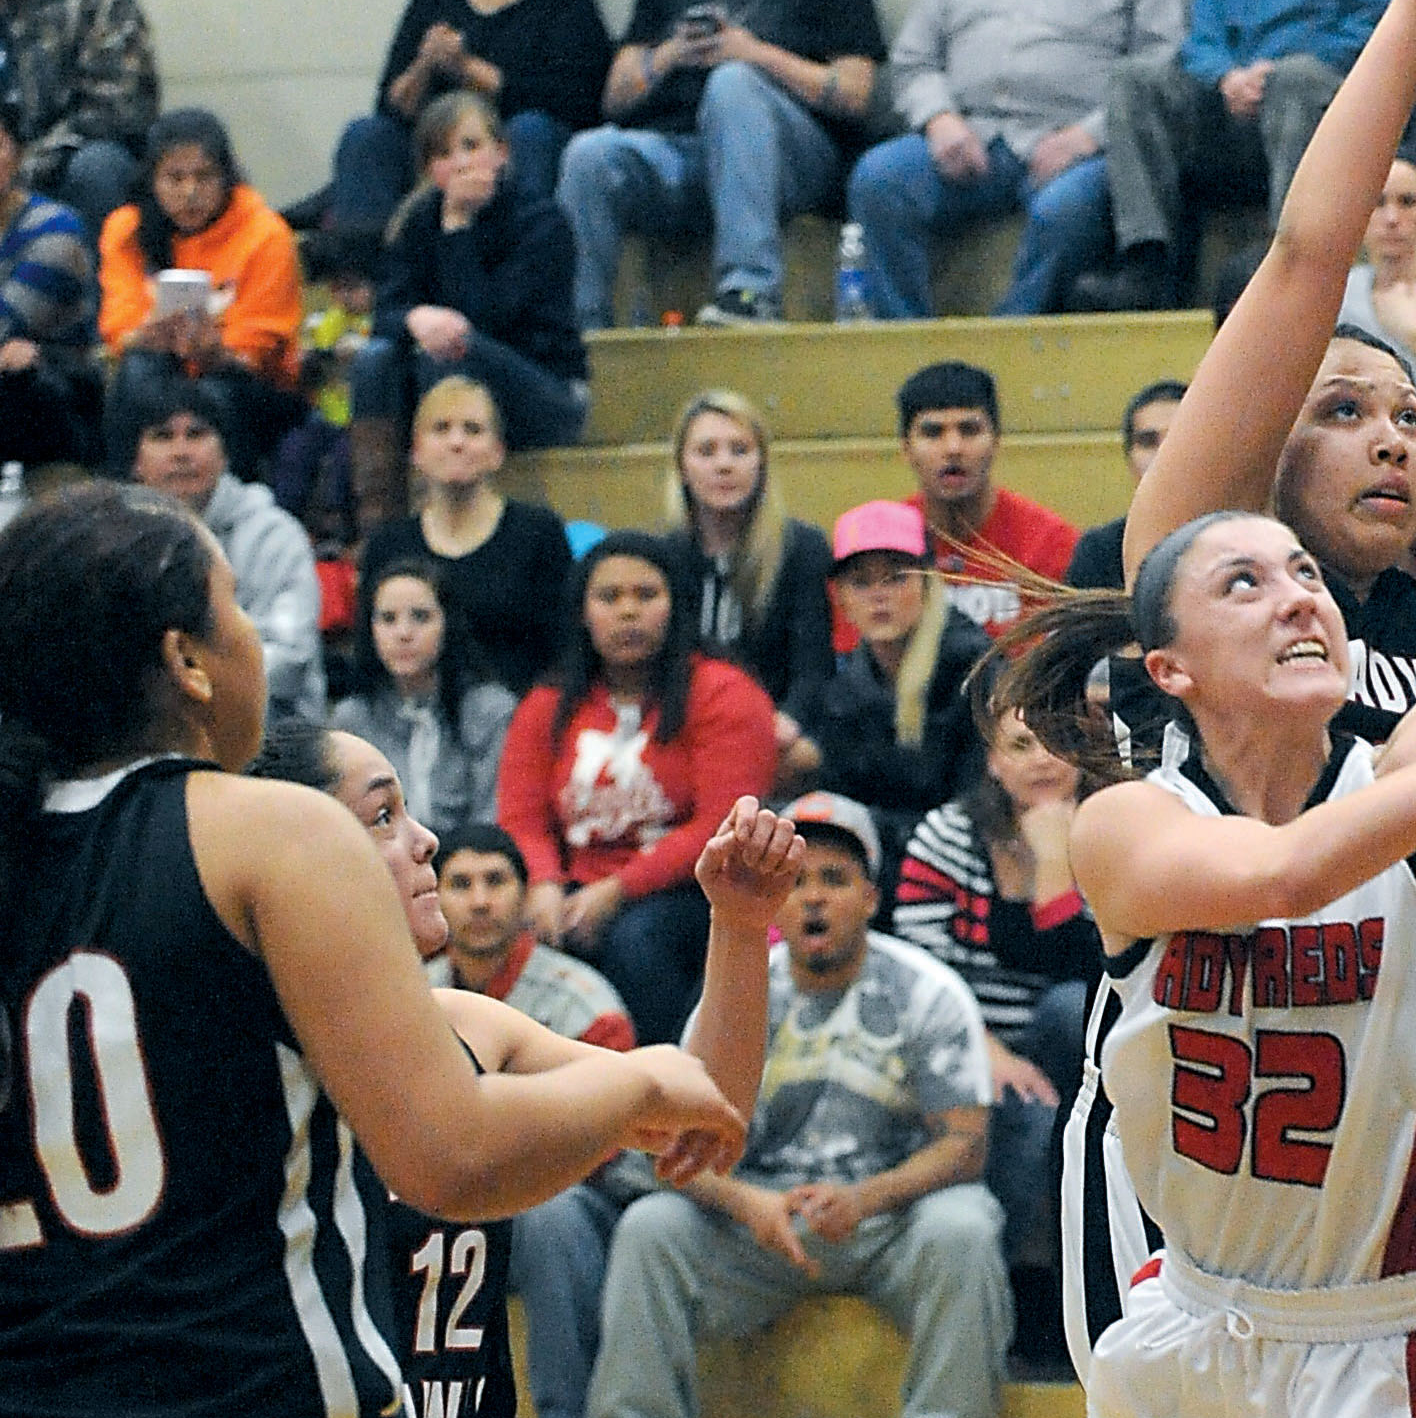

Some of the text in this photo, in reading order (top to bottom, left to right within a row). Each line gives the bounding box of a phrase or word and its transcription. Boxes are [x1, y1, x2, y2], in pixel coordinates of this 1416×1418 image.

[1153, 916, 1386, 1018] ADY REDS
[0, 945, 168, 1249] 0
[1167, 1022, 1347, 1190] 32
[408, 1228, 488, 1355] 12
